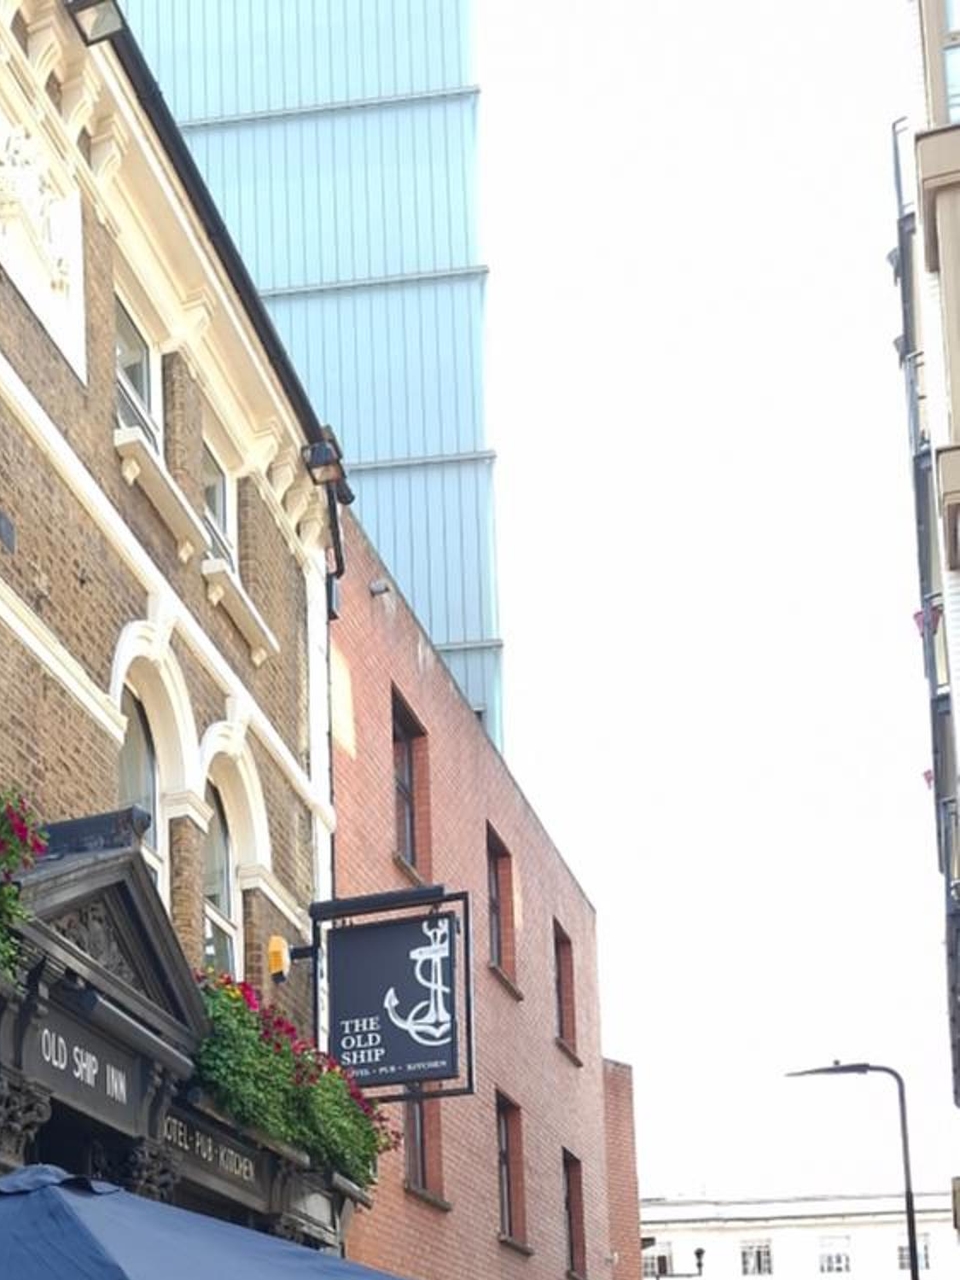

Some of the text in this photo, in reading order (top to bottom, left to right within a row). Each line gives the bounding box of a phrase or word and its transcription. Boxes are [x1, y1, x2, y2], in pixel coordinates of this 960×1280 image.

[340, 1017, 380, 1034] THE
[341, 1033, 381, 1050] OLD
[341, 1048, 386, 1066] SHIP
[41, 1028, 127, 1104] OLD SHIP INN
